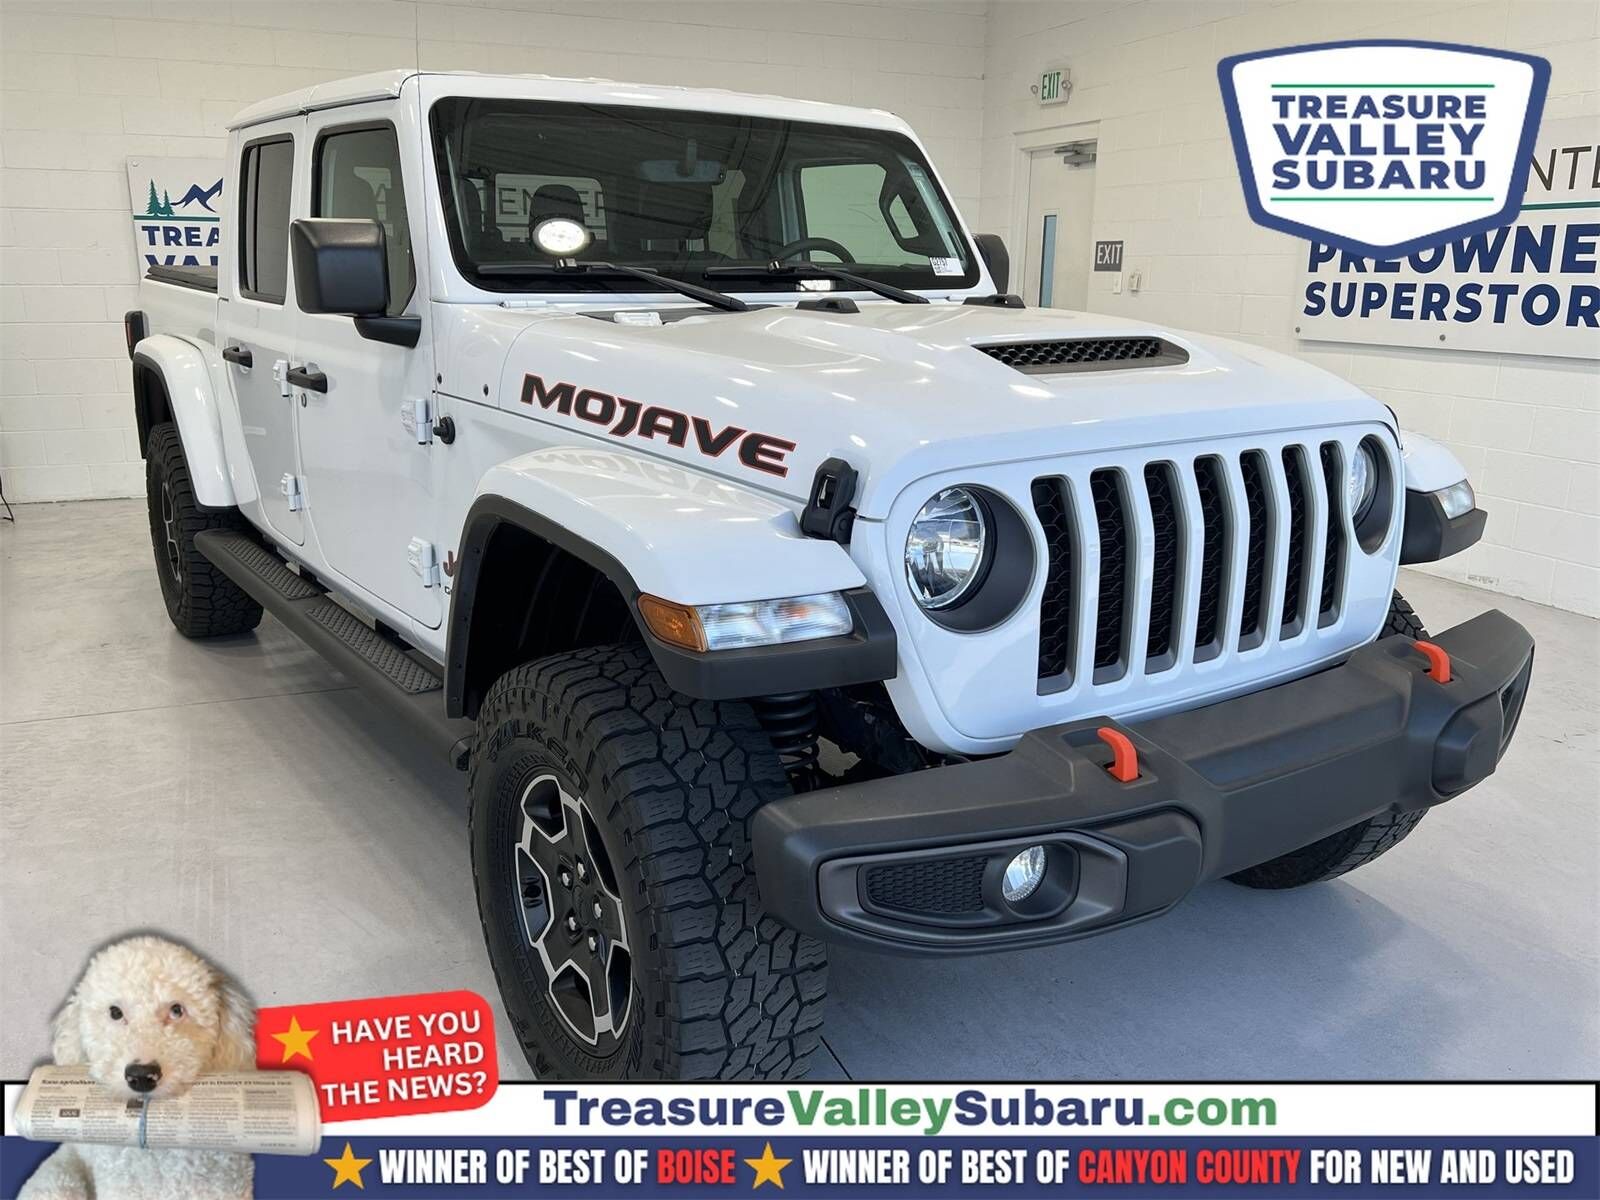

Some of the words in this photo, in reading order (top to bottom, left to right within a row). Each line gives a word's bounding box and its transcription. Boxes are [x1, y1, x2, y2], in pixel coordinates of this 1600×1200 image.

[1041, 71, 1061, 100] EXIT
[141, 225, 219, 247] TREA
[1096, 243, 1122, 264] EXIT
[1303, 281, 1600, 328] SUPERSTOR
[520, 373, 796, 479] MOJAVE
